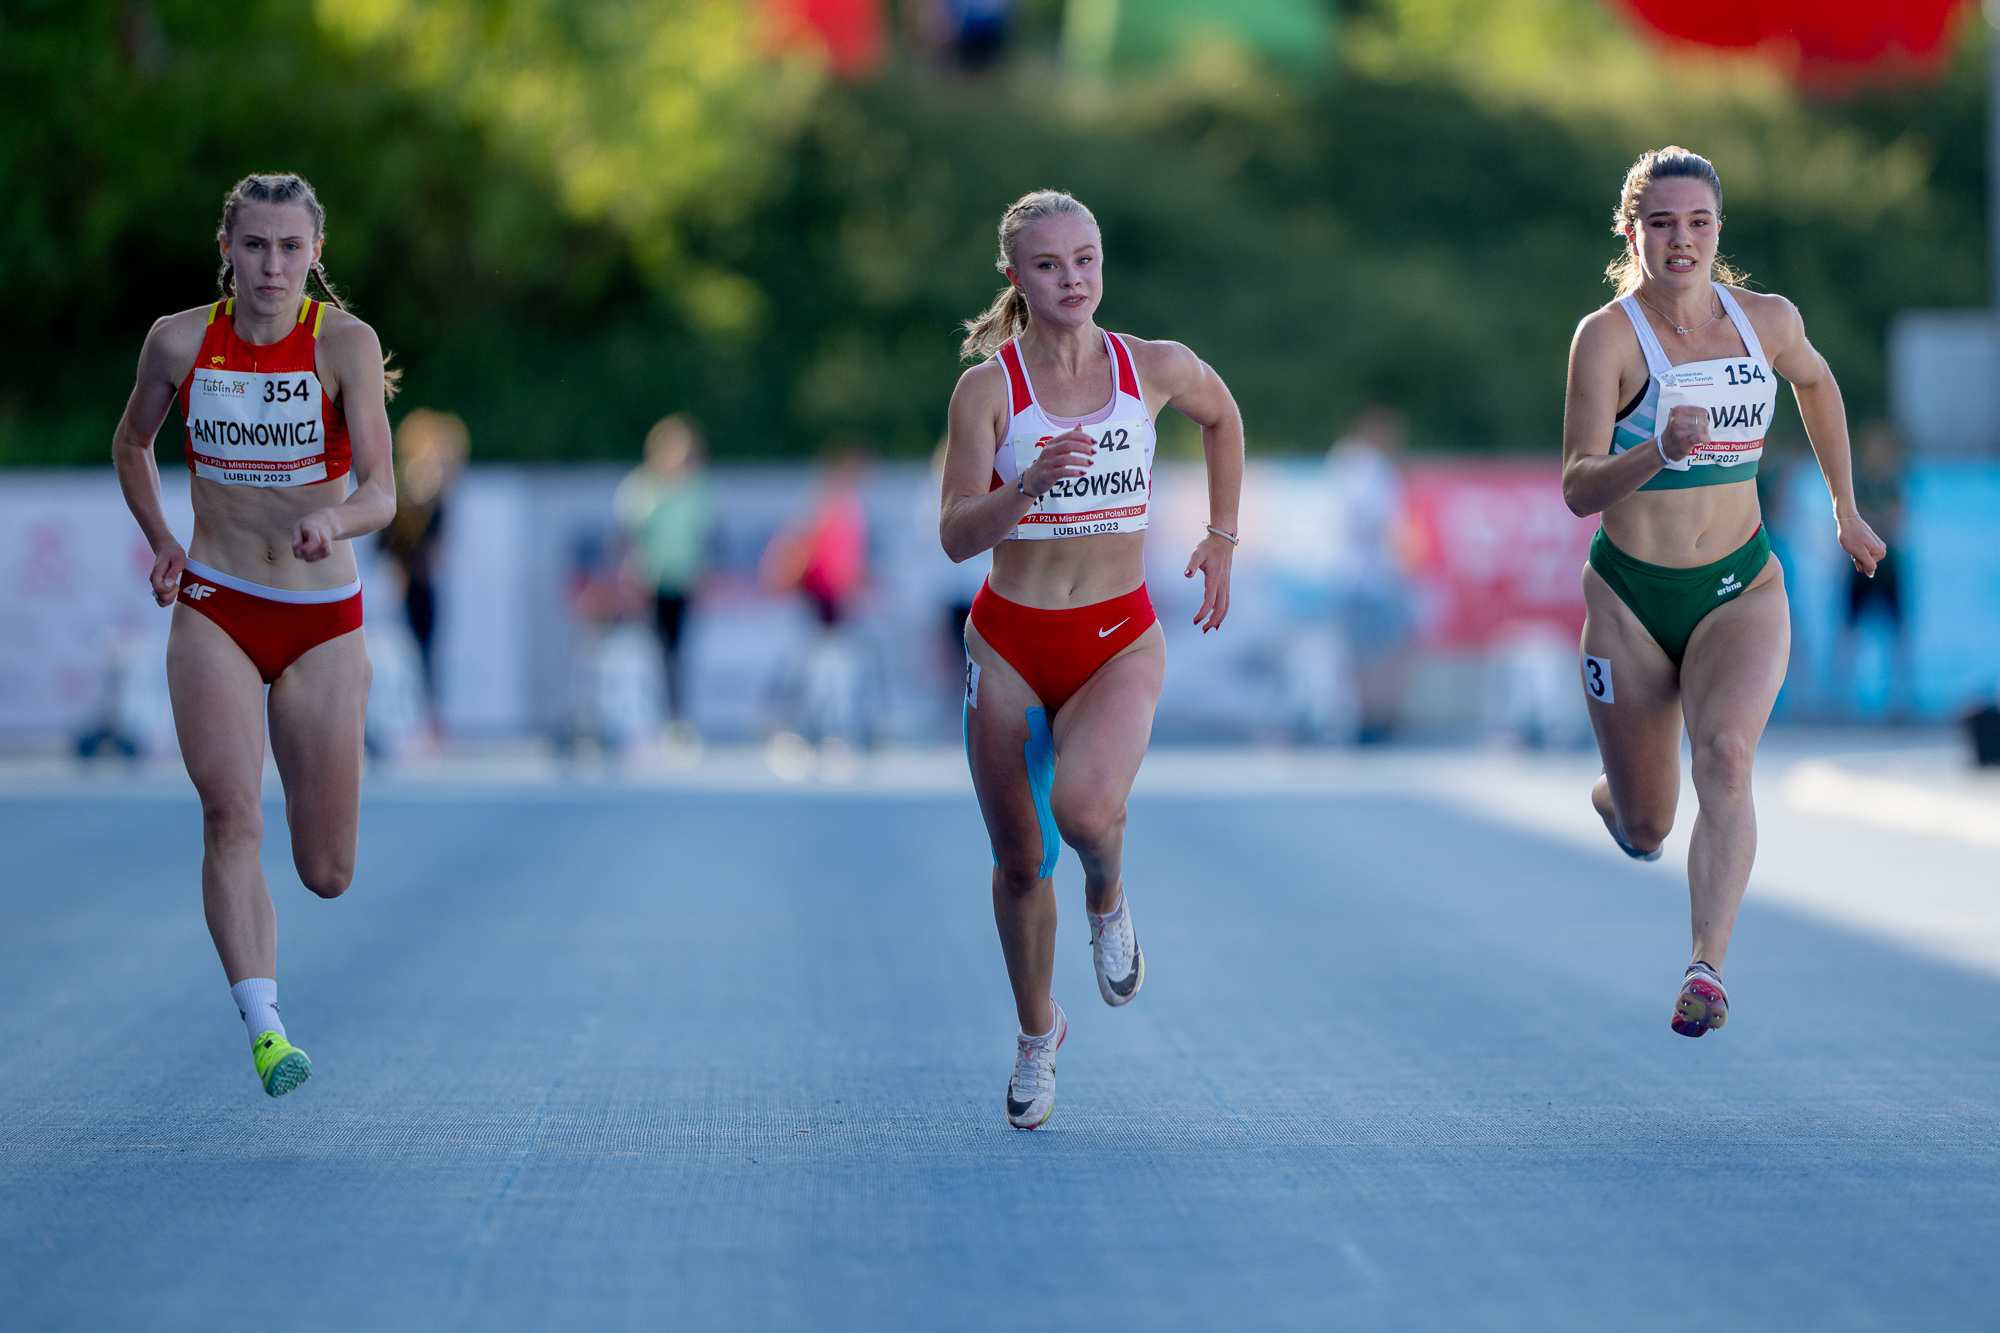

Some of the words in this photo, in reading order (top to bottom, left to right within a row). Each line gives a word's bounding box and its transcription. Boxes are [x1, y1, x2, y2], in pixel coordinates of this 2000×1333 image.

[1724, 364, 1766, 386] 154
[263, 379, 310, 403] 354
[1707, 402, 1767, 429] WAK
[194, 418, 318, 447] ANTONOWICZ
[1099, 428, 1131, 452] 42
[1731, 443, 1749, 451] Polski
[200, 456, 211, 464] 77.
[211, 459, 227, 468] PZLA
[228, 461, 276, 470] Mistrzostwa
[277, 461, 300, 470] Polski
[301, 457, 317, 467] U20
[1716, 454, 1740, 463] 2023
[223, 472, 261, 482] LUBLIN
[263, 473, 292, 483] 2023
[1027, 515, 1039, 523] 77.
[1040, 515, 1058, 523] PZLA
[1058, 512, 1104, 524] Mistrzostwa
[1105, 508, 1128, 519] Polski
[1128, 507, 1142, 516] U20
[1053, 525, 1091, 536] LUBLIN
[1093, 522, 1119, 532] 2023
[182, 583, 217, 600] 4F
[1717, 580, 1743, 597] erima
[1586, 658, 1605, 697] 3
